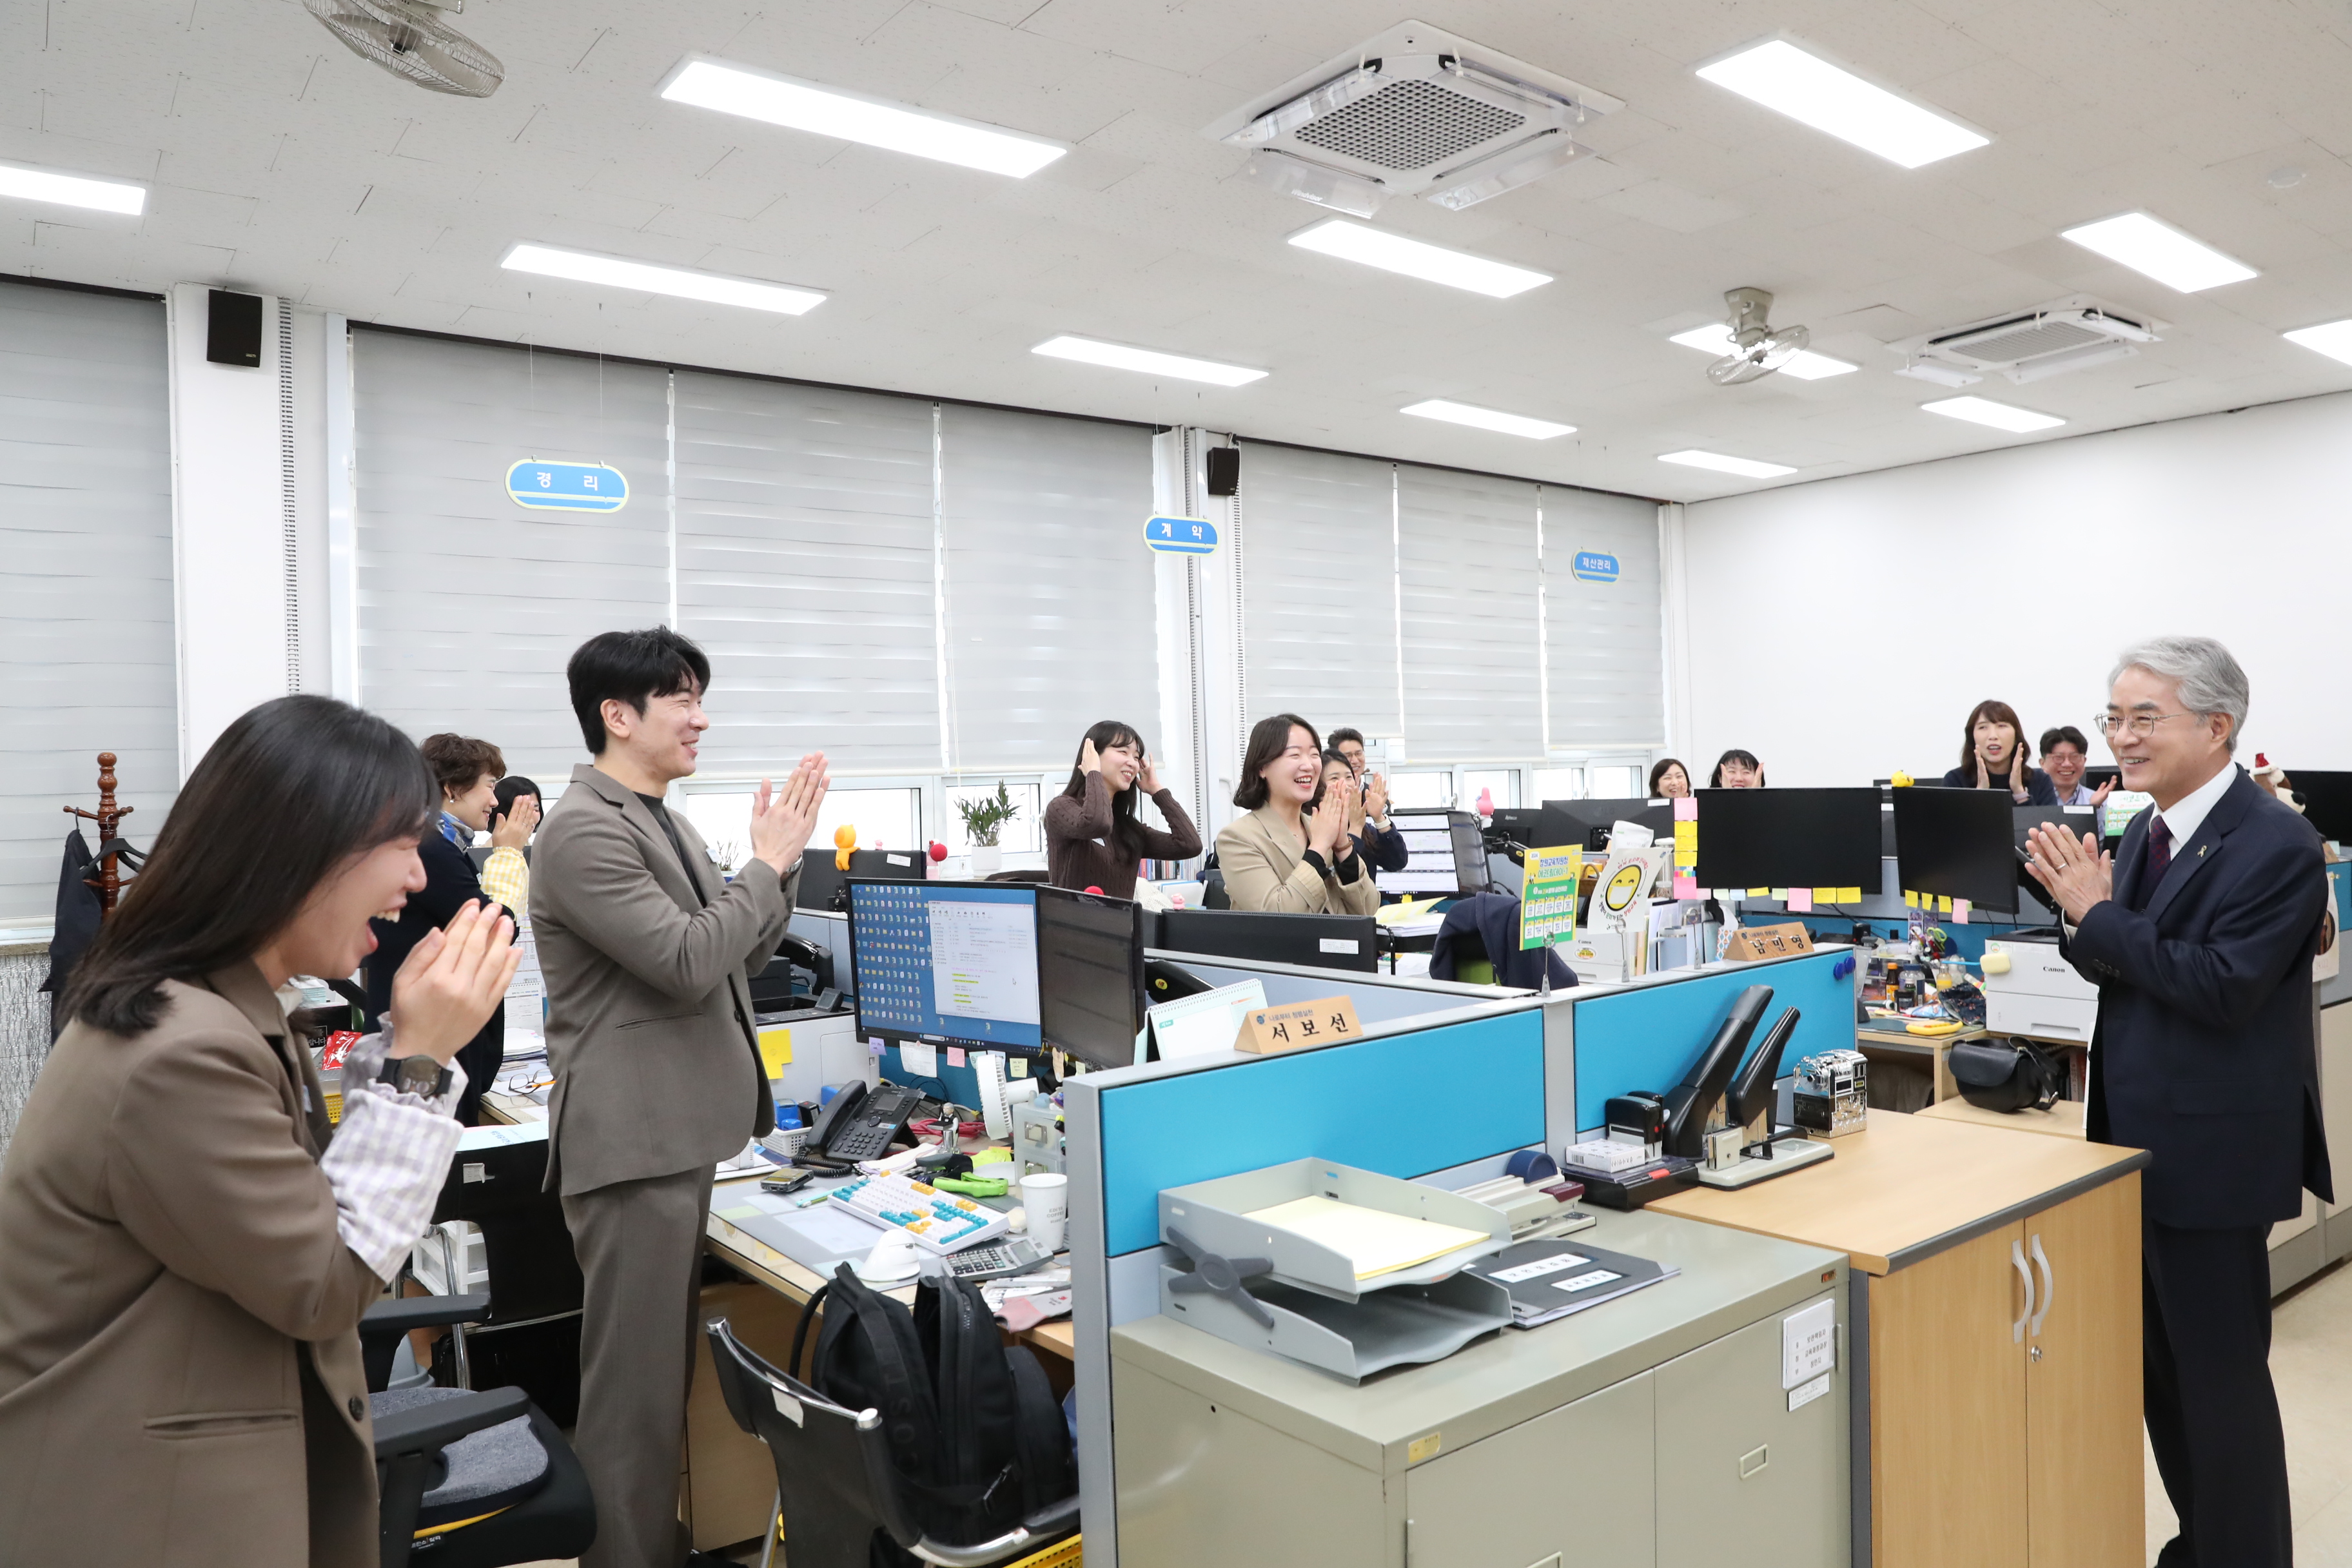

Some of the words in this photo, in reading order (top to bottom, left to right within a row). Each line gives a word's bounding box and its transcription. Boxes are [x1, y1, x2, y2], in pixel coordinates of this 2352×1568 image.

[1582, 557, 1611, 571] 재산관리
[1268, 1012, 1291, 1021] 나로부터
[1292, 1009, 1313, 1018] 청렴실천
